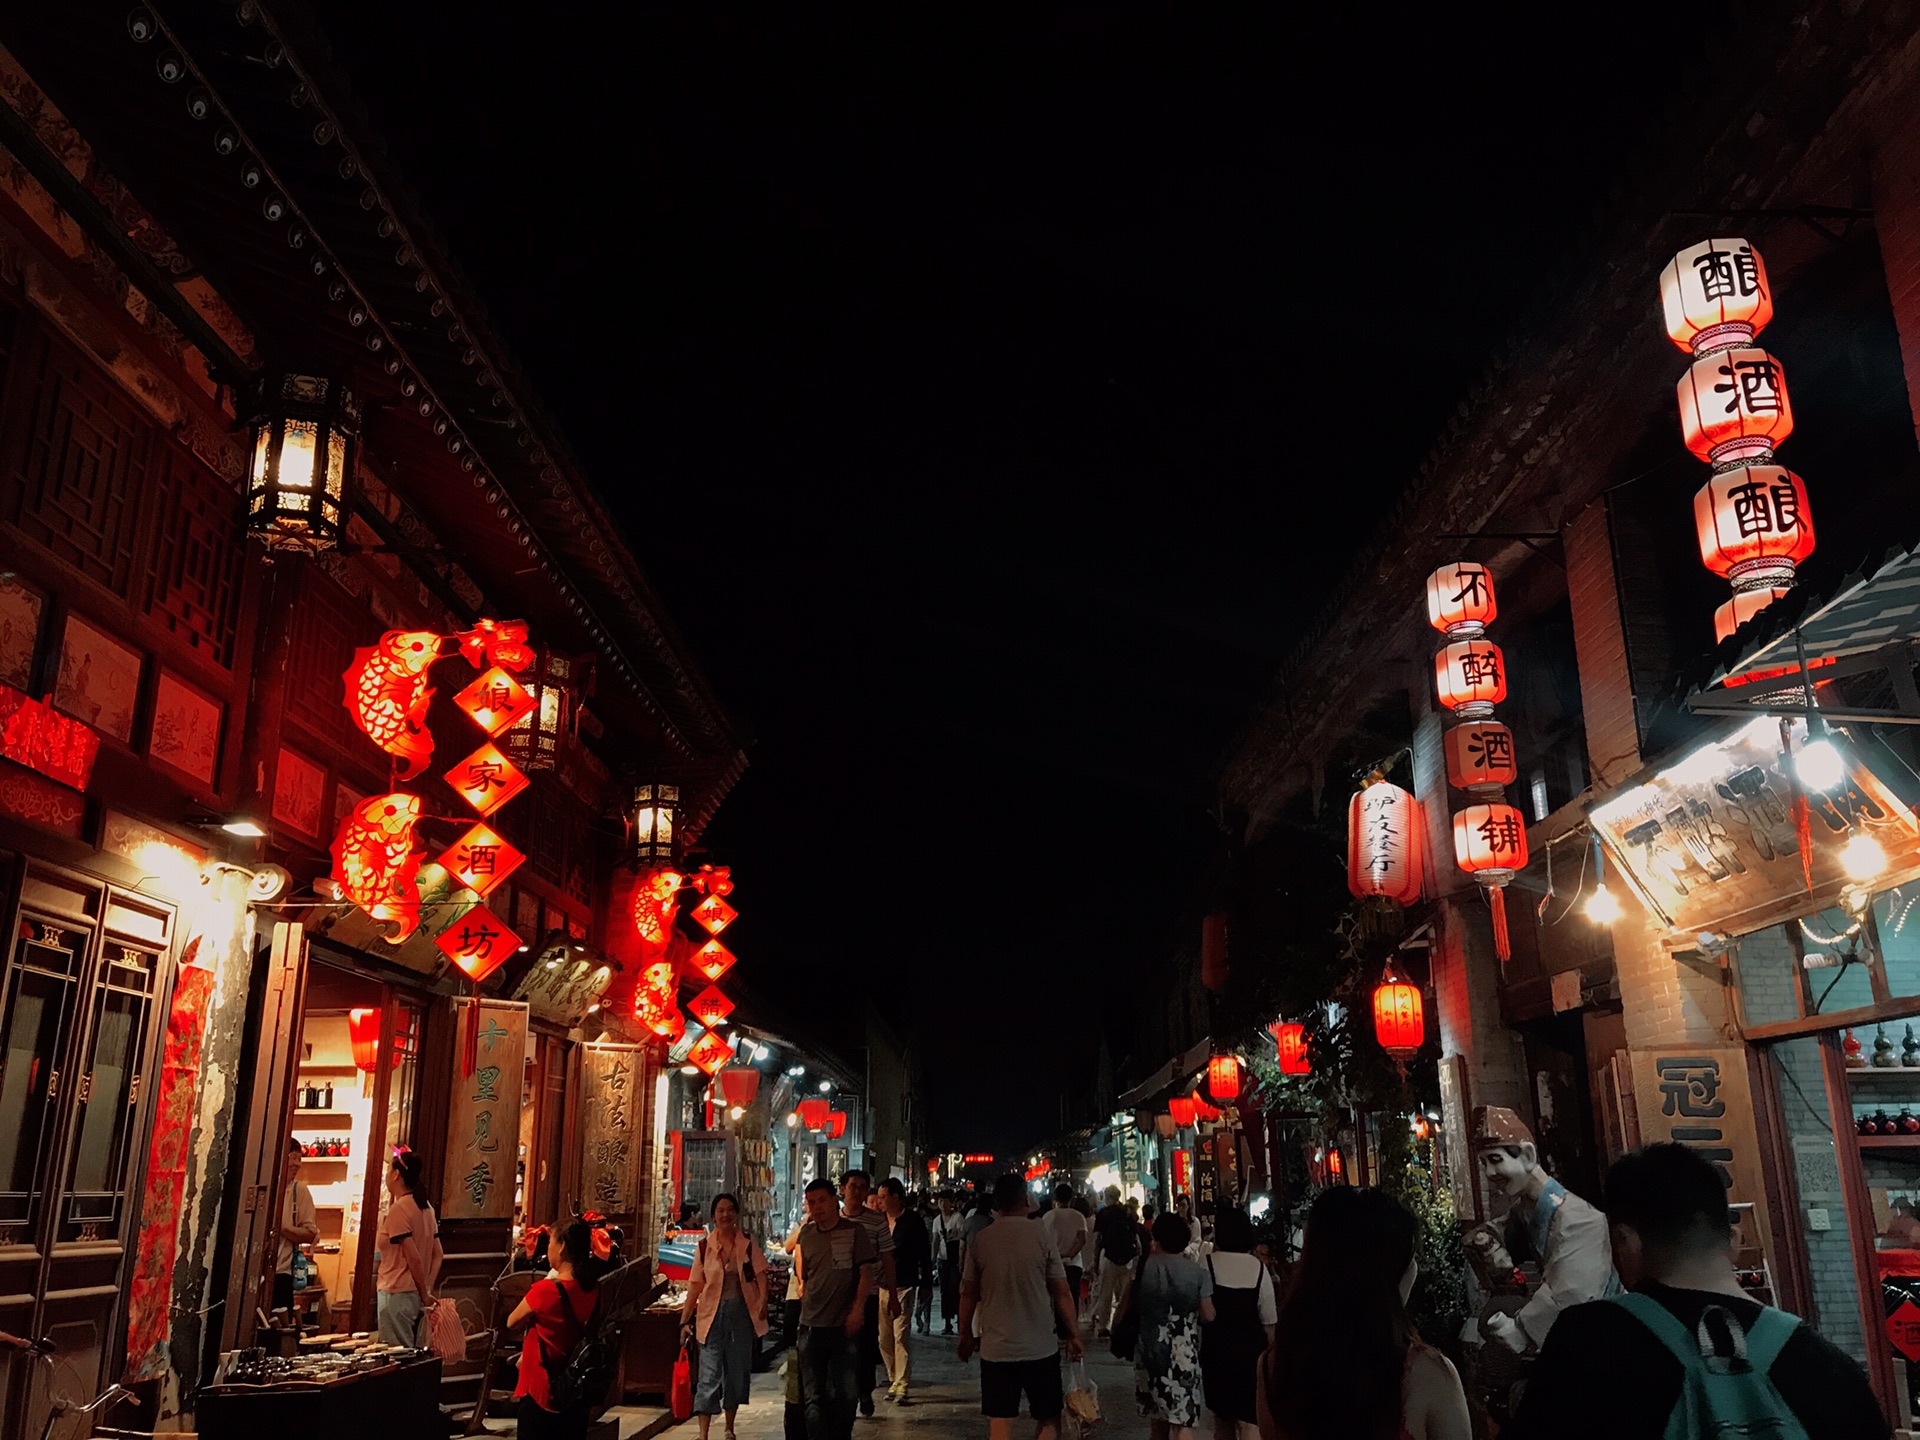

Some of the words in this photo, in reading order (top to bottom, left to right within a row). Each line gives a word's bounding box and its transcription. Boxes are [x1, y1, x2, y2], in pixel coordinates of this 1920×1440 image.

[1694, 246, 1807, 538] 酿酒酿
[455, 682, 513, 959] 娘家酒坊
[1451, 570, 1520, 853] 不醉酒铺
[698, 903, 725, 1064] 娘家醋坊
[464, 1019, 508, 1209] 十里见香
[595, 1060, 630, 1206] 古法酿造
